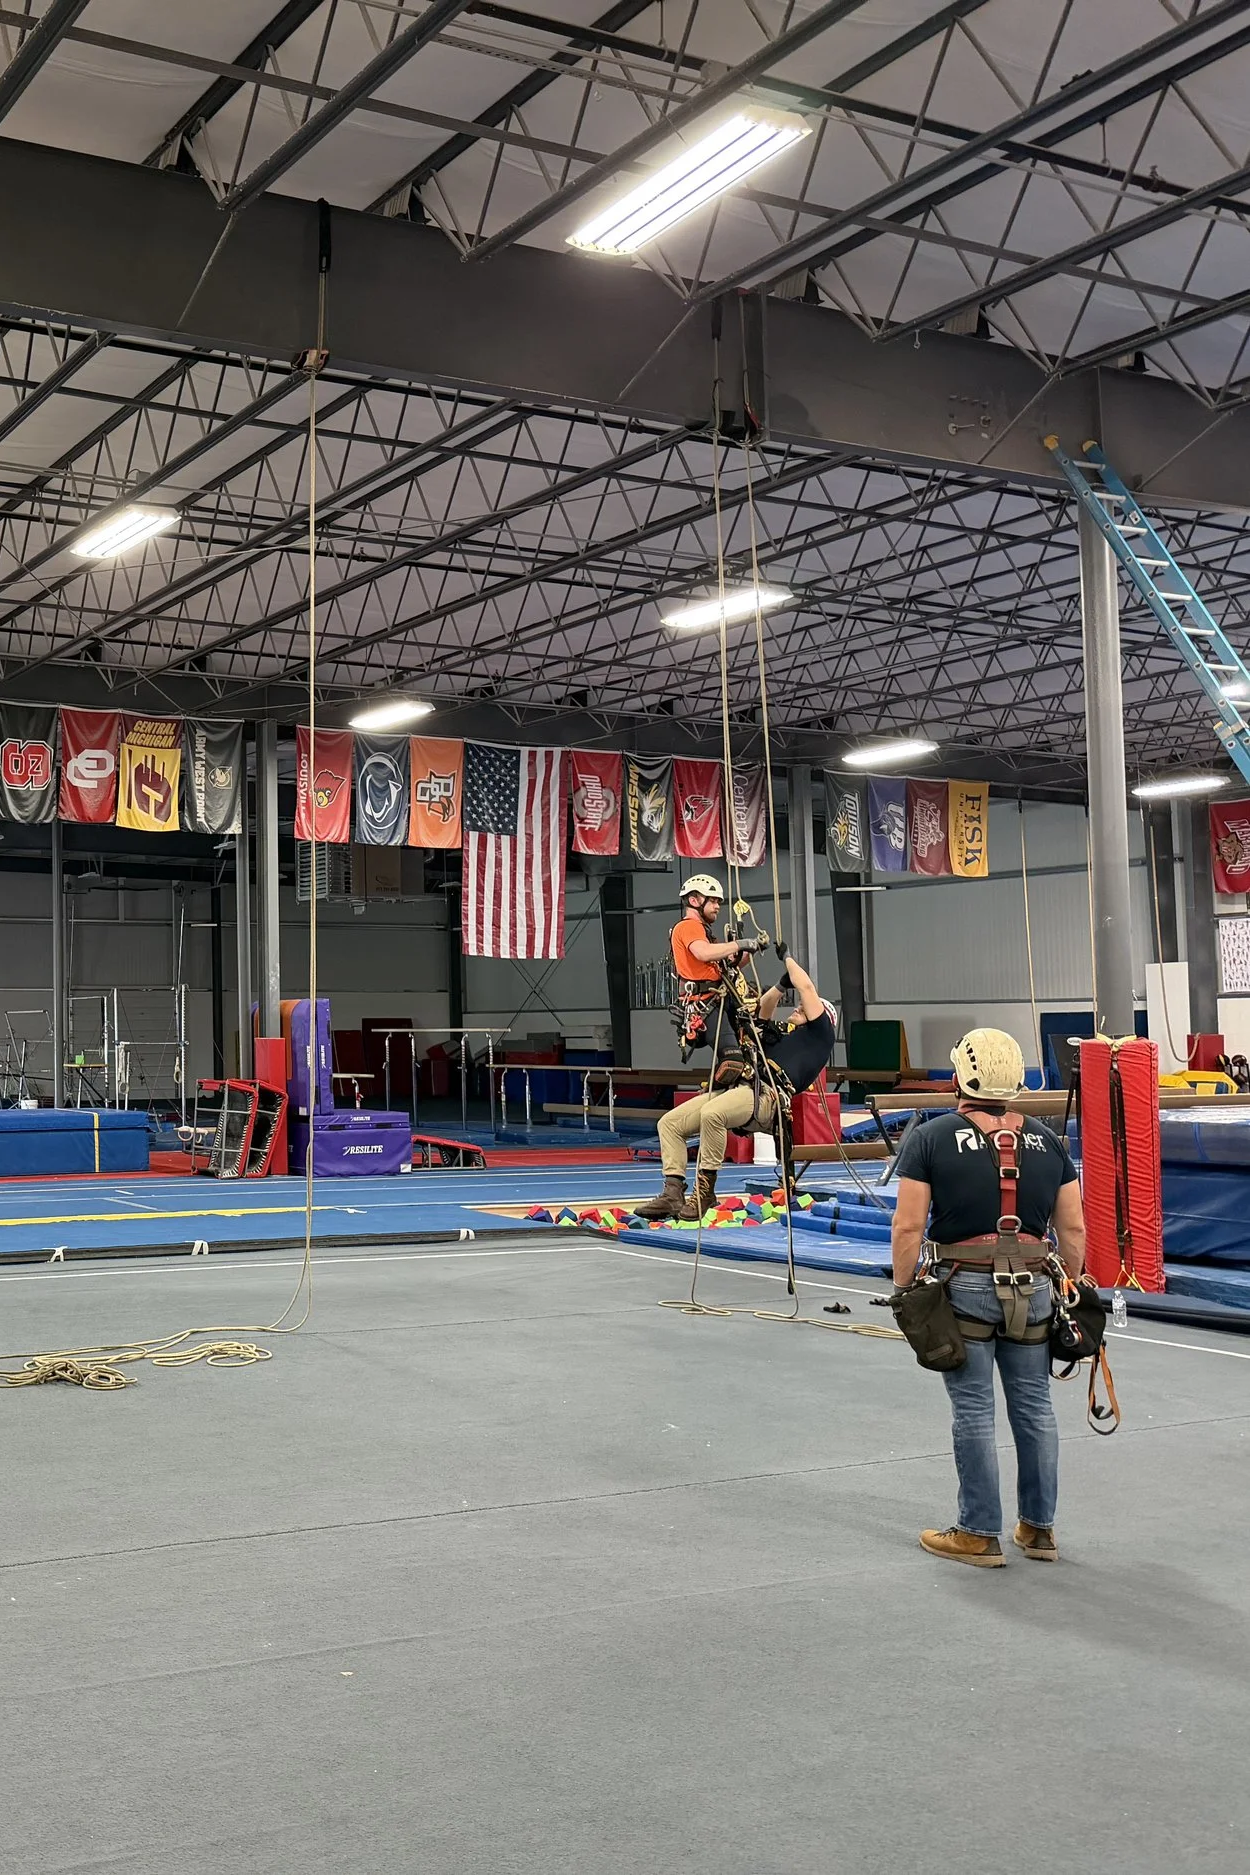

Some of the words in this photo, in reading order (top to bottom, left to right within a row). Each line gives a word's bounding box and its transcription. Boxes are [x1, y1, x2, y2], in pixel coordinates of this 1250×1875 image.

[125, 731, 176, 748] MICHIGAN
[133, 720, 176, 735] CENTRAL
[195, 729, 207, 759] ARMY
[195, 760, 206, 791] WEST
[195, 793, 206, 823] POINT
[628, 763, 640, 851] MISSOURI
[733, 775, 752, 858] Centenary
[843, 792, 861, 857] TOWSON
[964, 794, 983, 866] FISK
[350, 1145, 384, 1154] RESILITE
